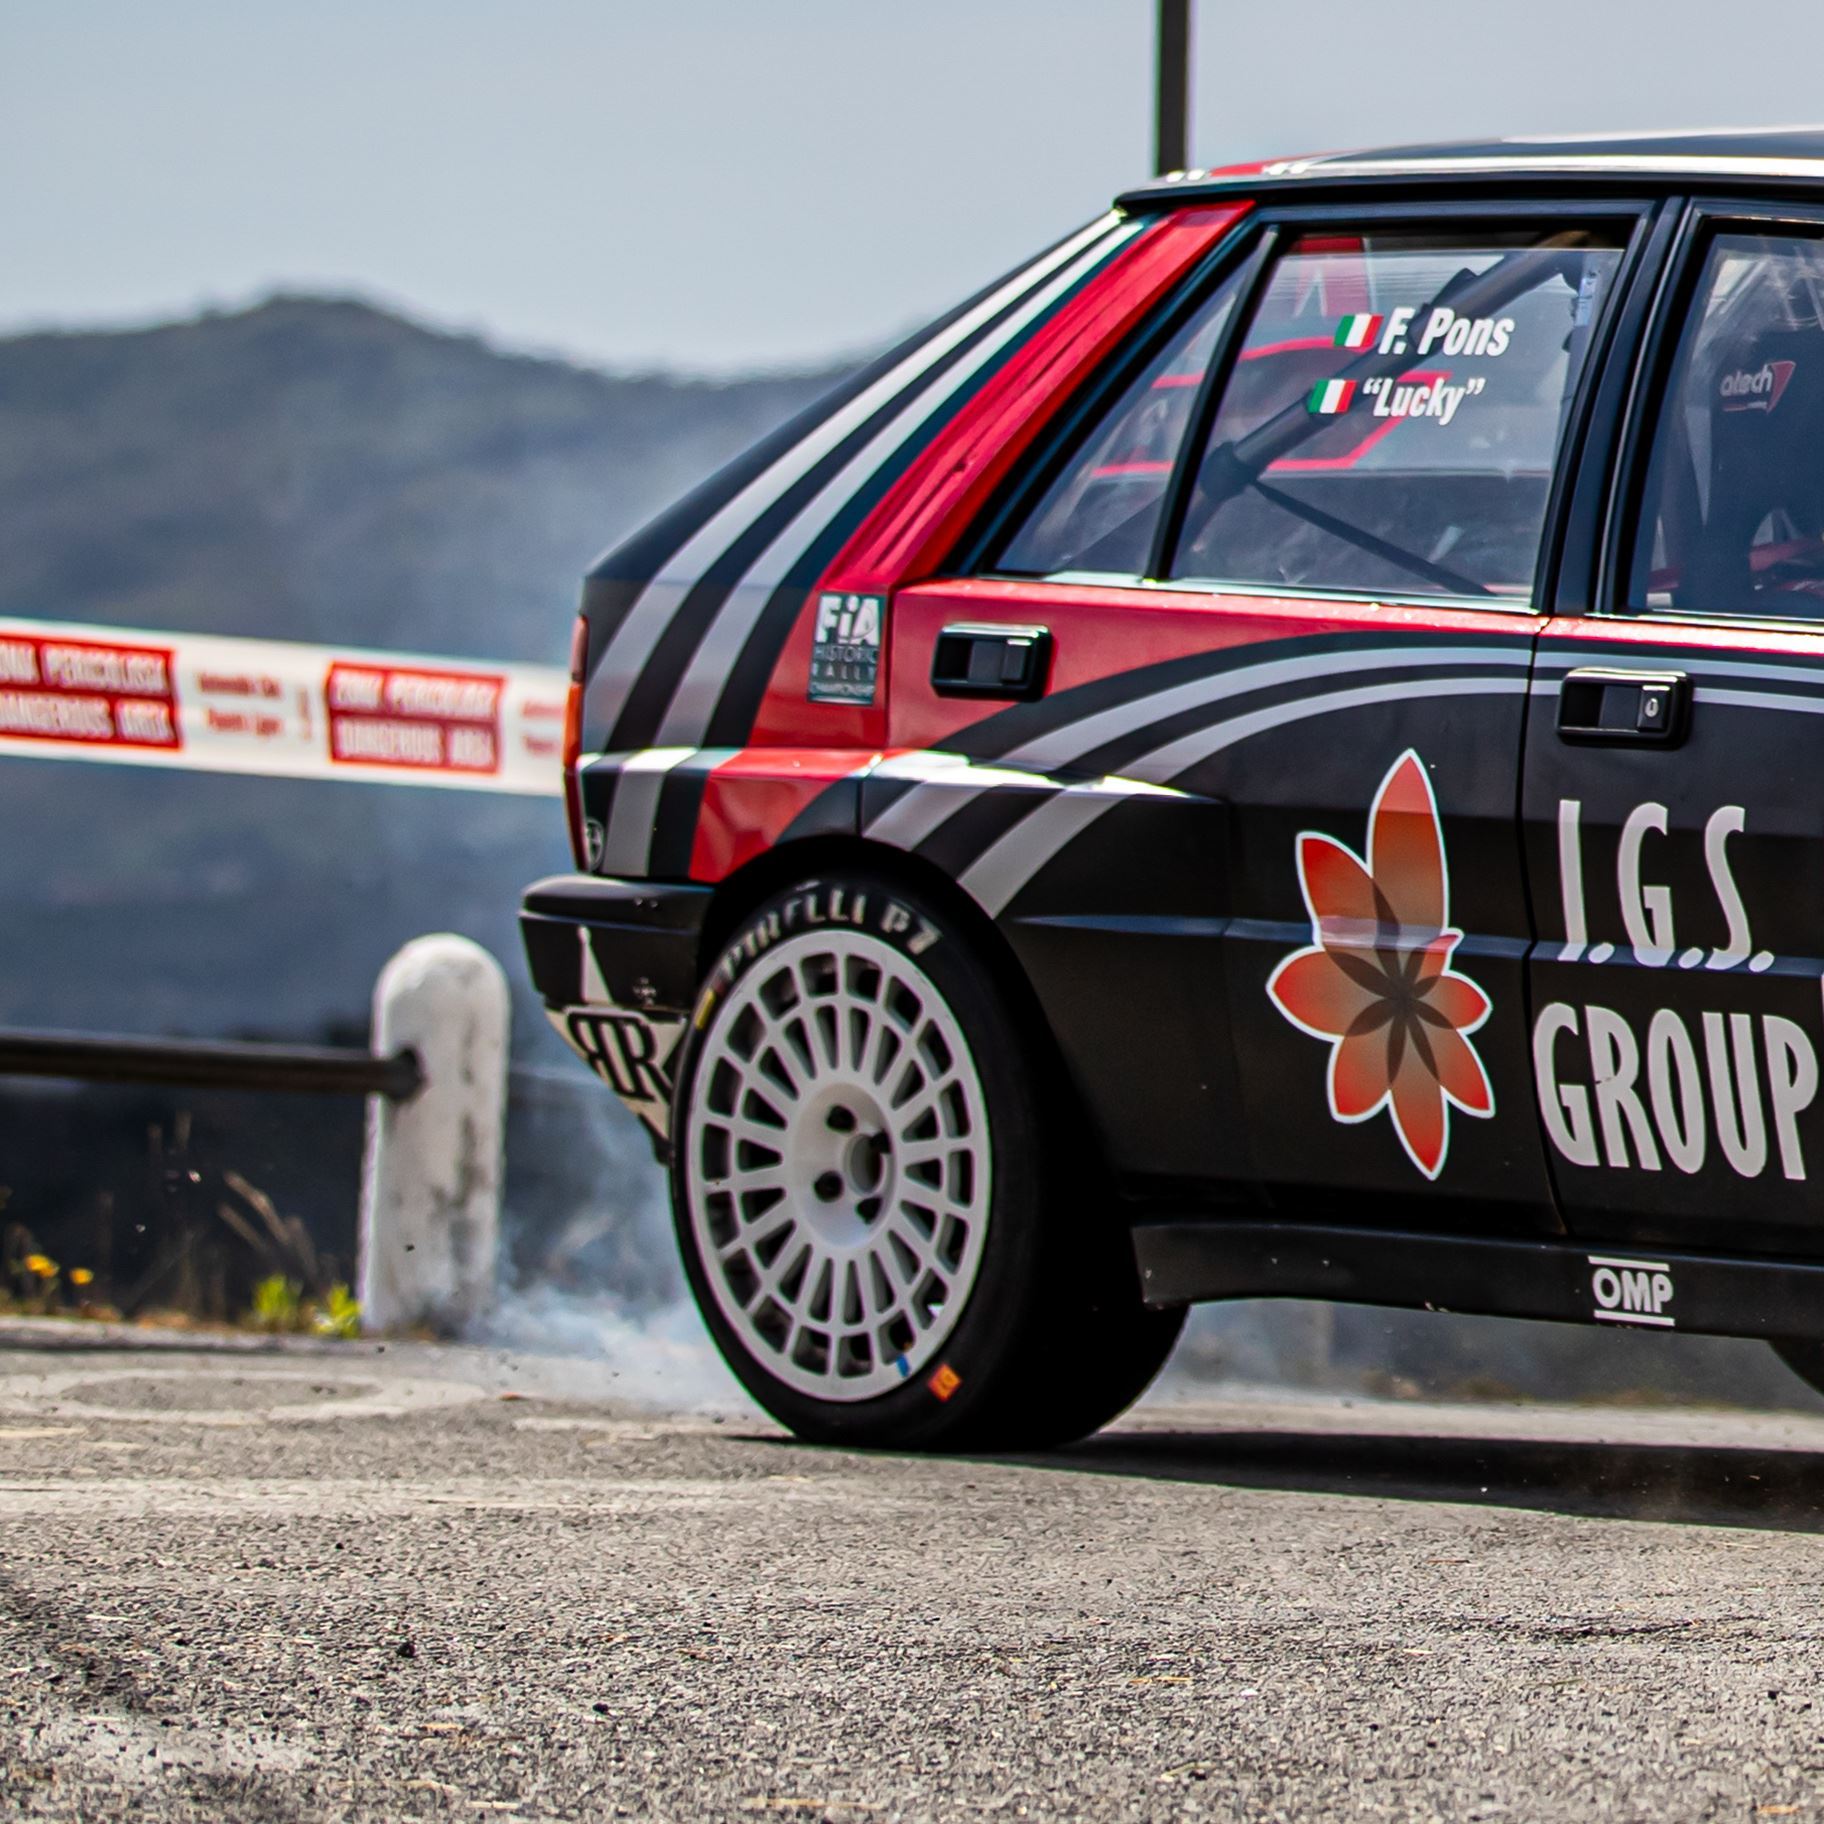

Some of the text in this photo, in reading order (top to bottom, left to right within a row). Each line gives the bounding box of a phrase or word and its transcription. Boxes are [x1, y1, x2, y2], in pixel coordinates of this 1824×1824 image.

[1378, 306, 1515, 359] F. Pons
[1532, 1001, 1819, 1181] GROUP
[1591, 1266, 1675, 1315] OMP
